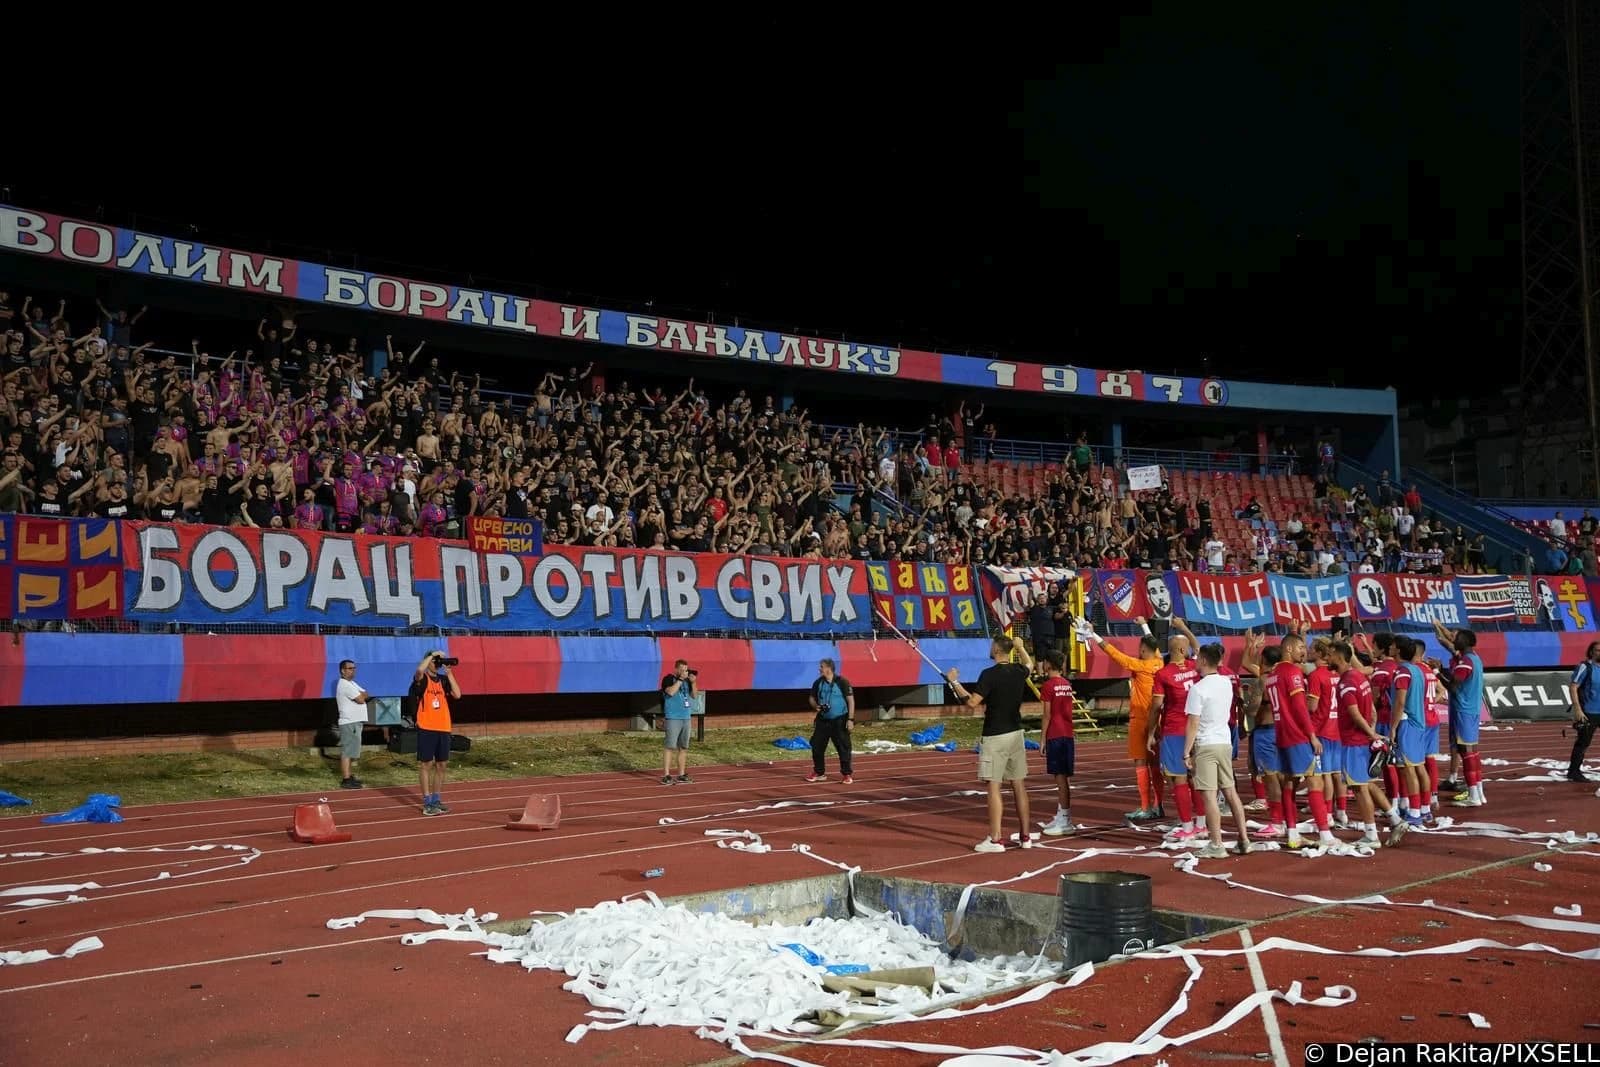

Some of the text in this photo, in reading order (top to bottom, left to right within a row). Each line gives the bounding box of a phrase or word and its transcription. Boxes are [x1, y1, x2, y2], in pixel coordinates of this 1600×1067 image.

[0, 208, 284, 294] ВОЛИМ
[324, 268, 537, 333] БОРАЦ
[560, 306, 600, 341] И
[626, 315, 900, 376] БАЊАЛУКУ
[473, 519, 533, 535] ЦРВЕНО
[474, 535, 533, 552] ПЛАВИ
[132, 526, 858, 626] БОРАЦ ПРОТИВ СВИХ
[1403, 602, 1460, 624] FIGHTER
